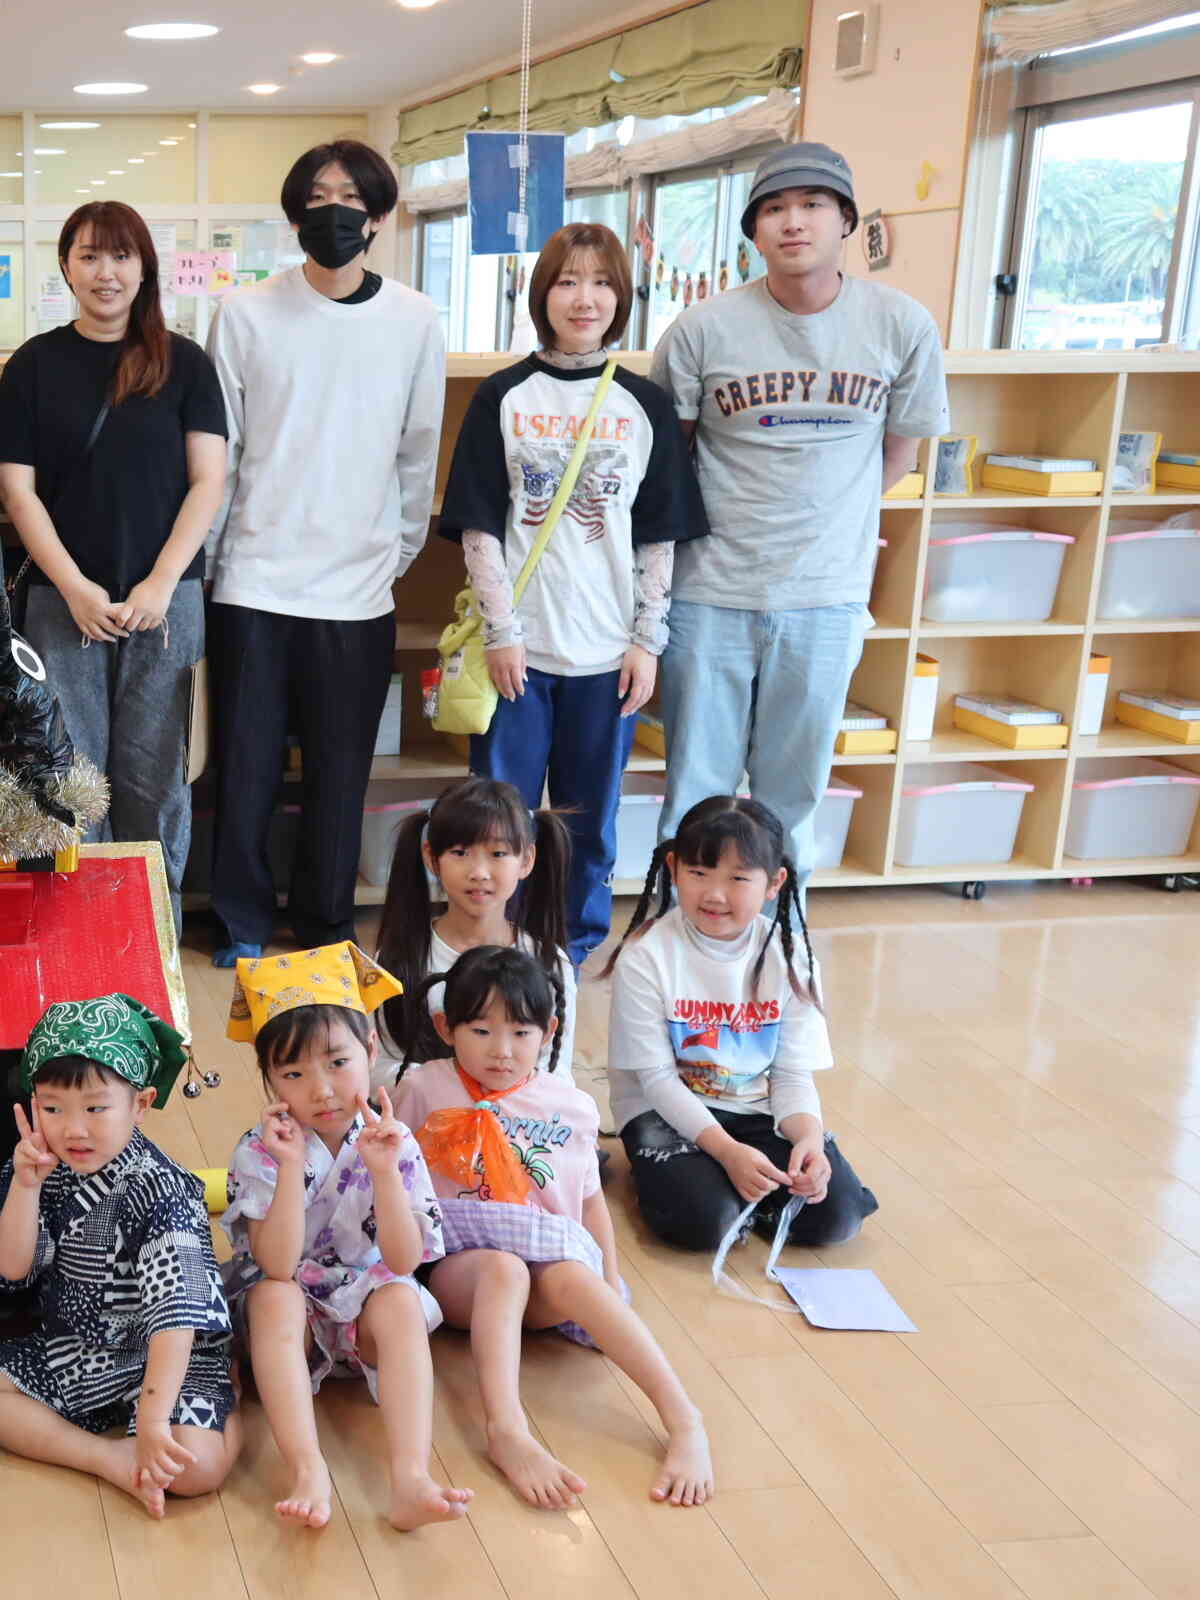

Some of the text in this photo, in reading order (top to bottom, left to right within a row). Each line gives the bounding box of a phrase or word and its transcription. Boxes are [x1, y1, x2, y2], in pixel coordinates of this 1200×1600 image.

[867, 221, 883, 258] 祭
[714, 371, 890, 417] CREEPY NUTS
[759, 415, 854, 429] Champion
[674, 999, 780, 1020] SUNNY AYS
